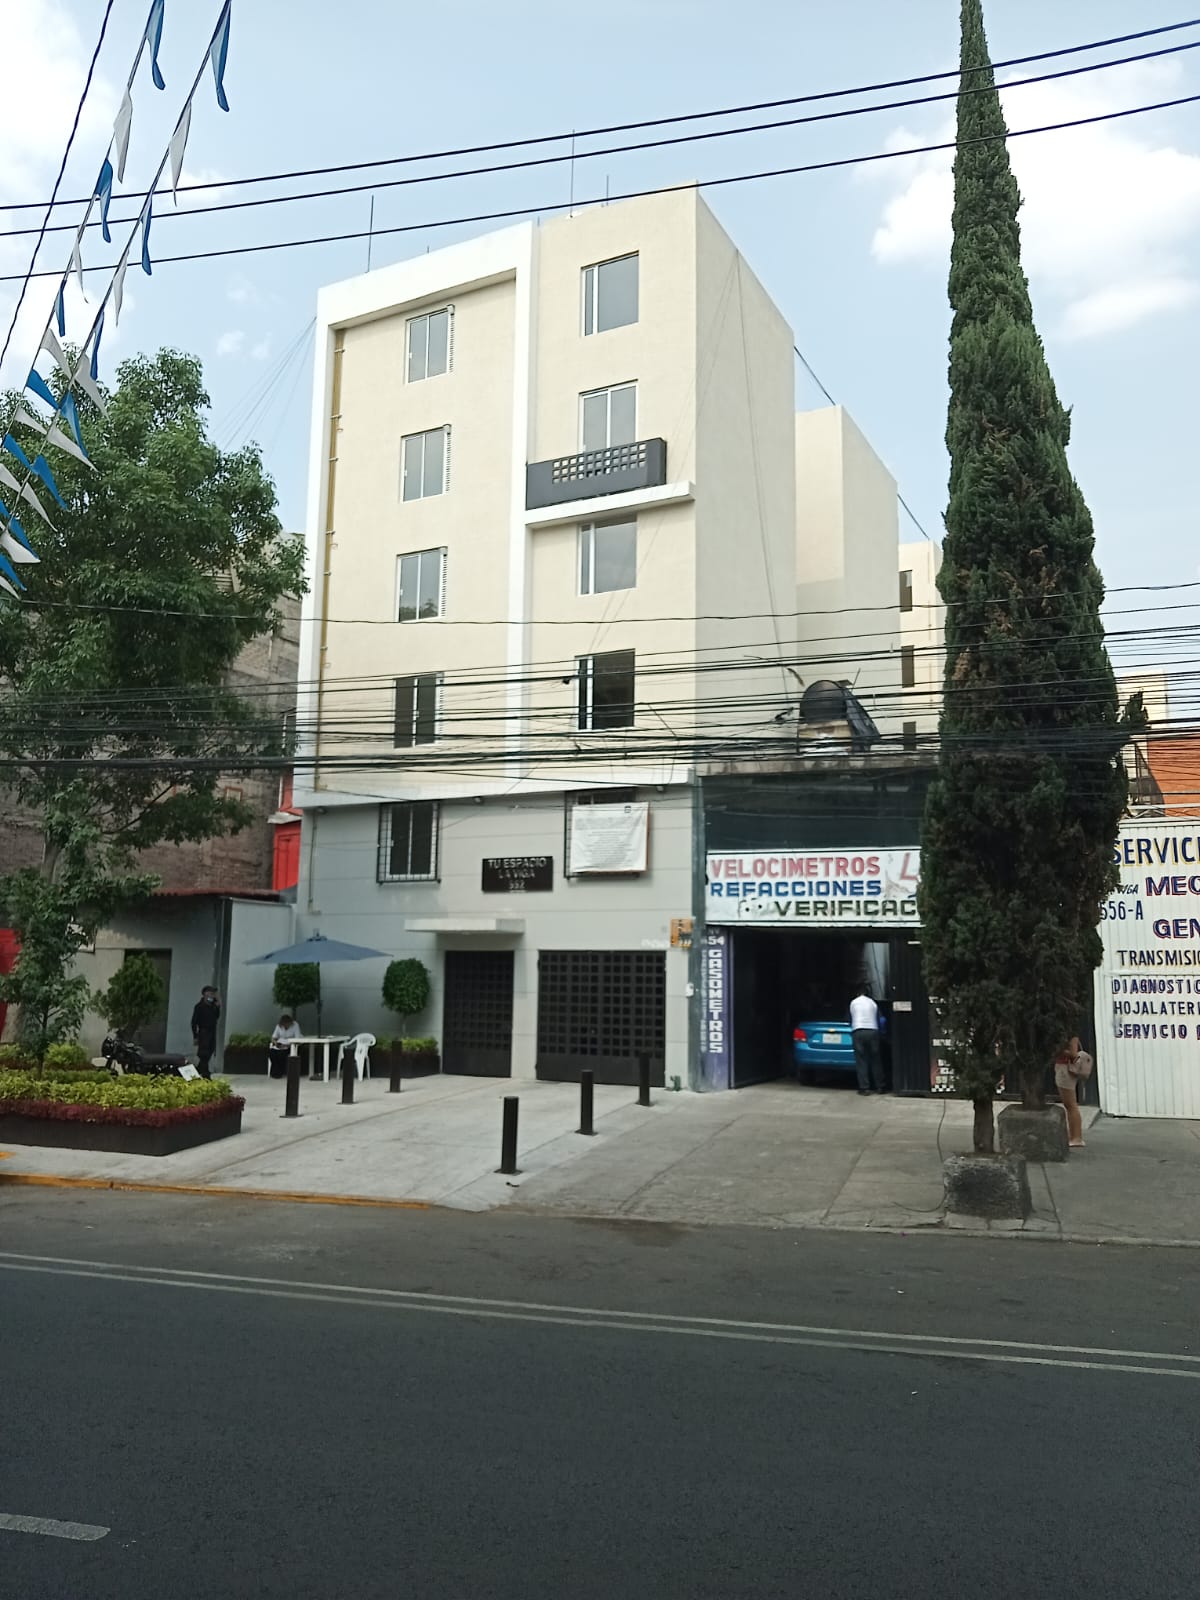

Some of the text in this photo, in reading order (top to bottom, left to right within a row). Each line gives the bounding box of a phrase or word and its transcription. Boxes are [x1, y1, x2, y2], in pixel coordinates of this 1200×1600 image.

[503, 857, 547, 868] ESPACIO
[711, 856, 881, 878] VELOCIMETROS
[710, 880, 882, 897] REFACCIONES
[1146, 876, 1200, 896] MEC
[774, 899, 917, 916] VERIFICAC
[1153, 918, 1200, 939] GEN
[708, 949, 723, 1053] GASOMETROS
[1115, 1024, 1187, 1039] SERVICIO
